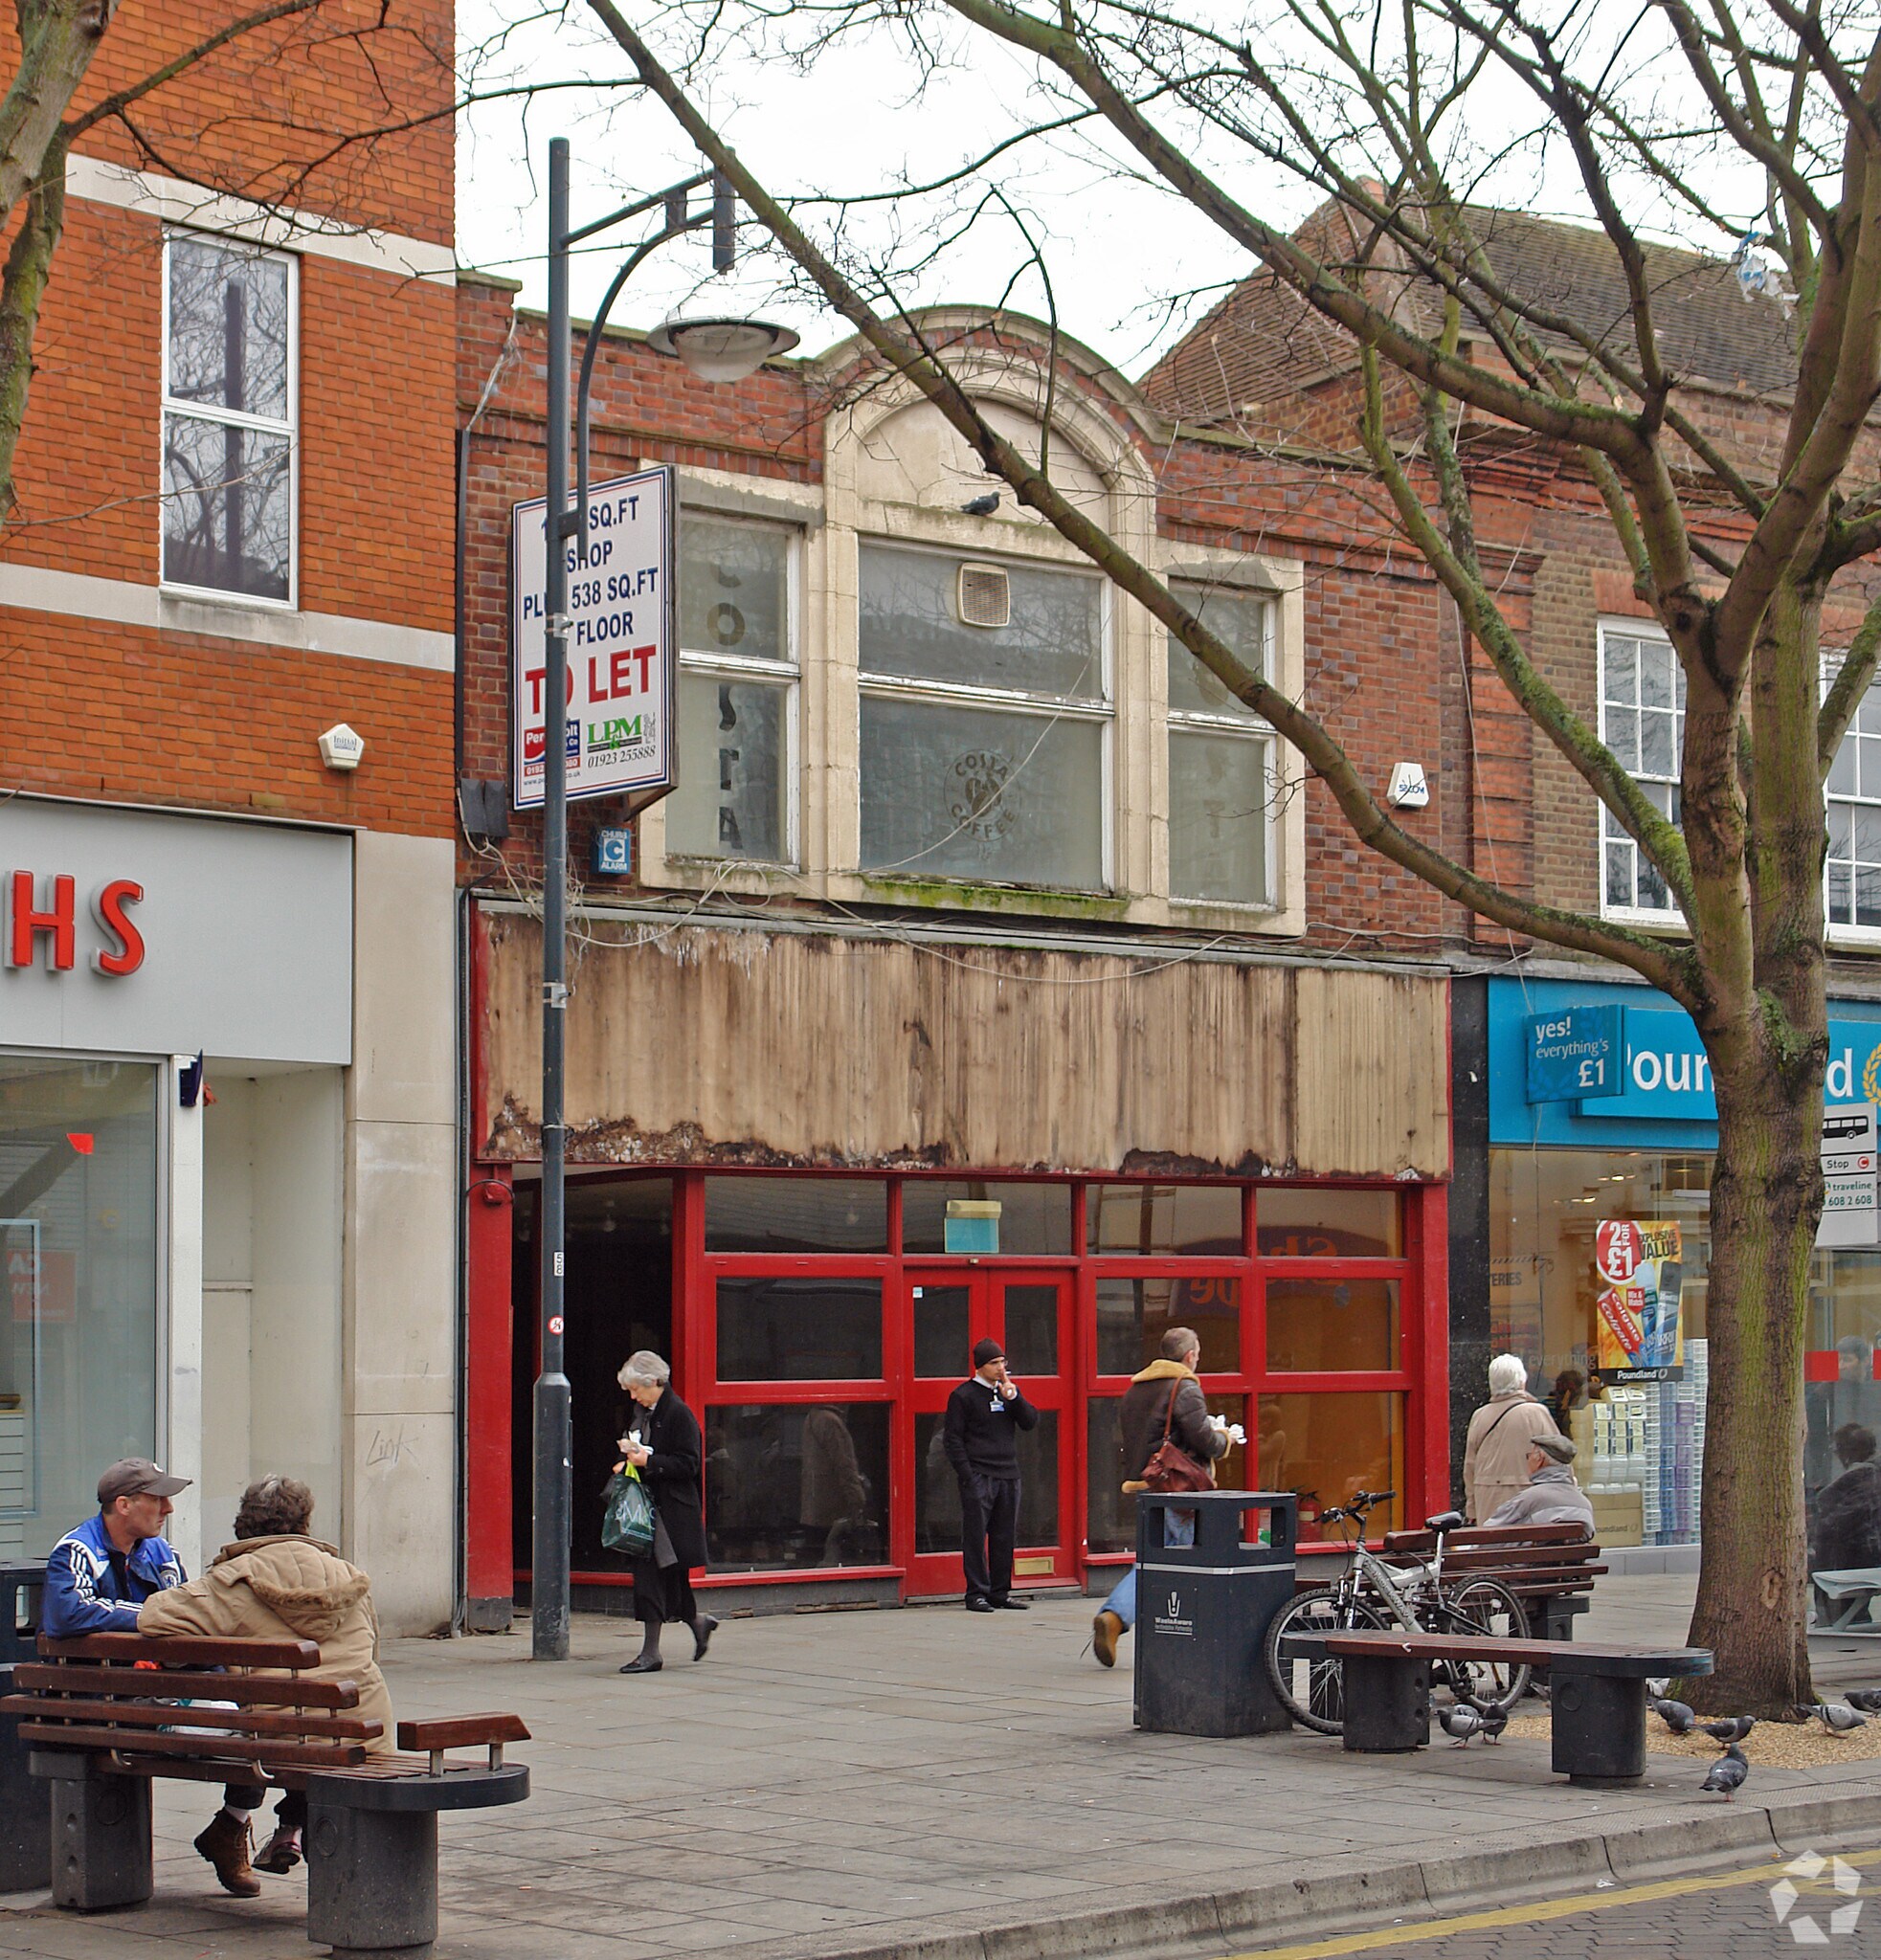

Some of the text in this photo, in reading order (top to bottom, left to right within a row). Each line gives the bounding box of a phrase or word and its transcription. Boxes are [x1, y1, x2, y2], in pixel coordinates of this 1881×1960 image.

[589, 495, 639, 530] SQ.FT
[571, 580, 601, 610] 538
[607, 567, 659, 602] SQ.FT
[576, 611, 634, 646] FLOOR
[588, 643, 657, 704] LET
[587, 715, 642, 745] LPM
[587, 753, 617, 768] 01923
[619, 745, 657, 764] 255888
[951, 803, 1016, 839] COFFEE
[601, 861, 627, 871] ALARM
[1535, 1015, 1572, 1045] yes!
[1535, 1037, 1609, 1060] everything's
[1579, 1058, 1605, 1088] £1
[1826, 1159, 1849, 1170] Stop
[1828, 1196, 1846, 1207] 608
[1848, 1195, 1854, 1206] 2
[1855, 1194, 1872, 1206] 608
[1832, 1180, 1872, 1192] traveline
[1609, 1221, 1630, 1247] 2 FOR
[1607, 1246, 1633, 1277] £1
[1601, 1302, 1632, 1350] Colgate
[1611, 1292, 1640, 1342] Colgate
[1617, 1370, 1657, 1380] Poundland
